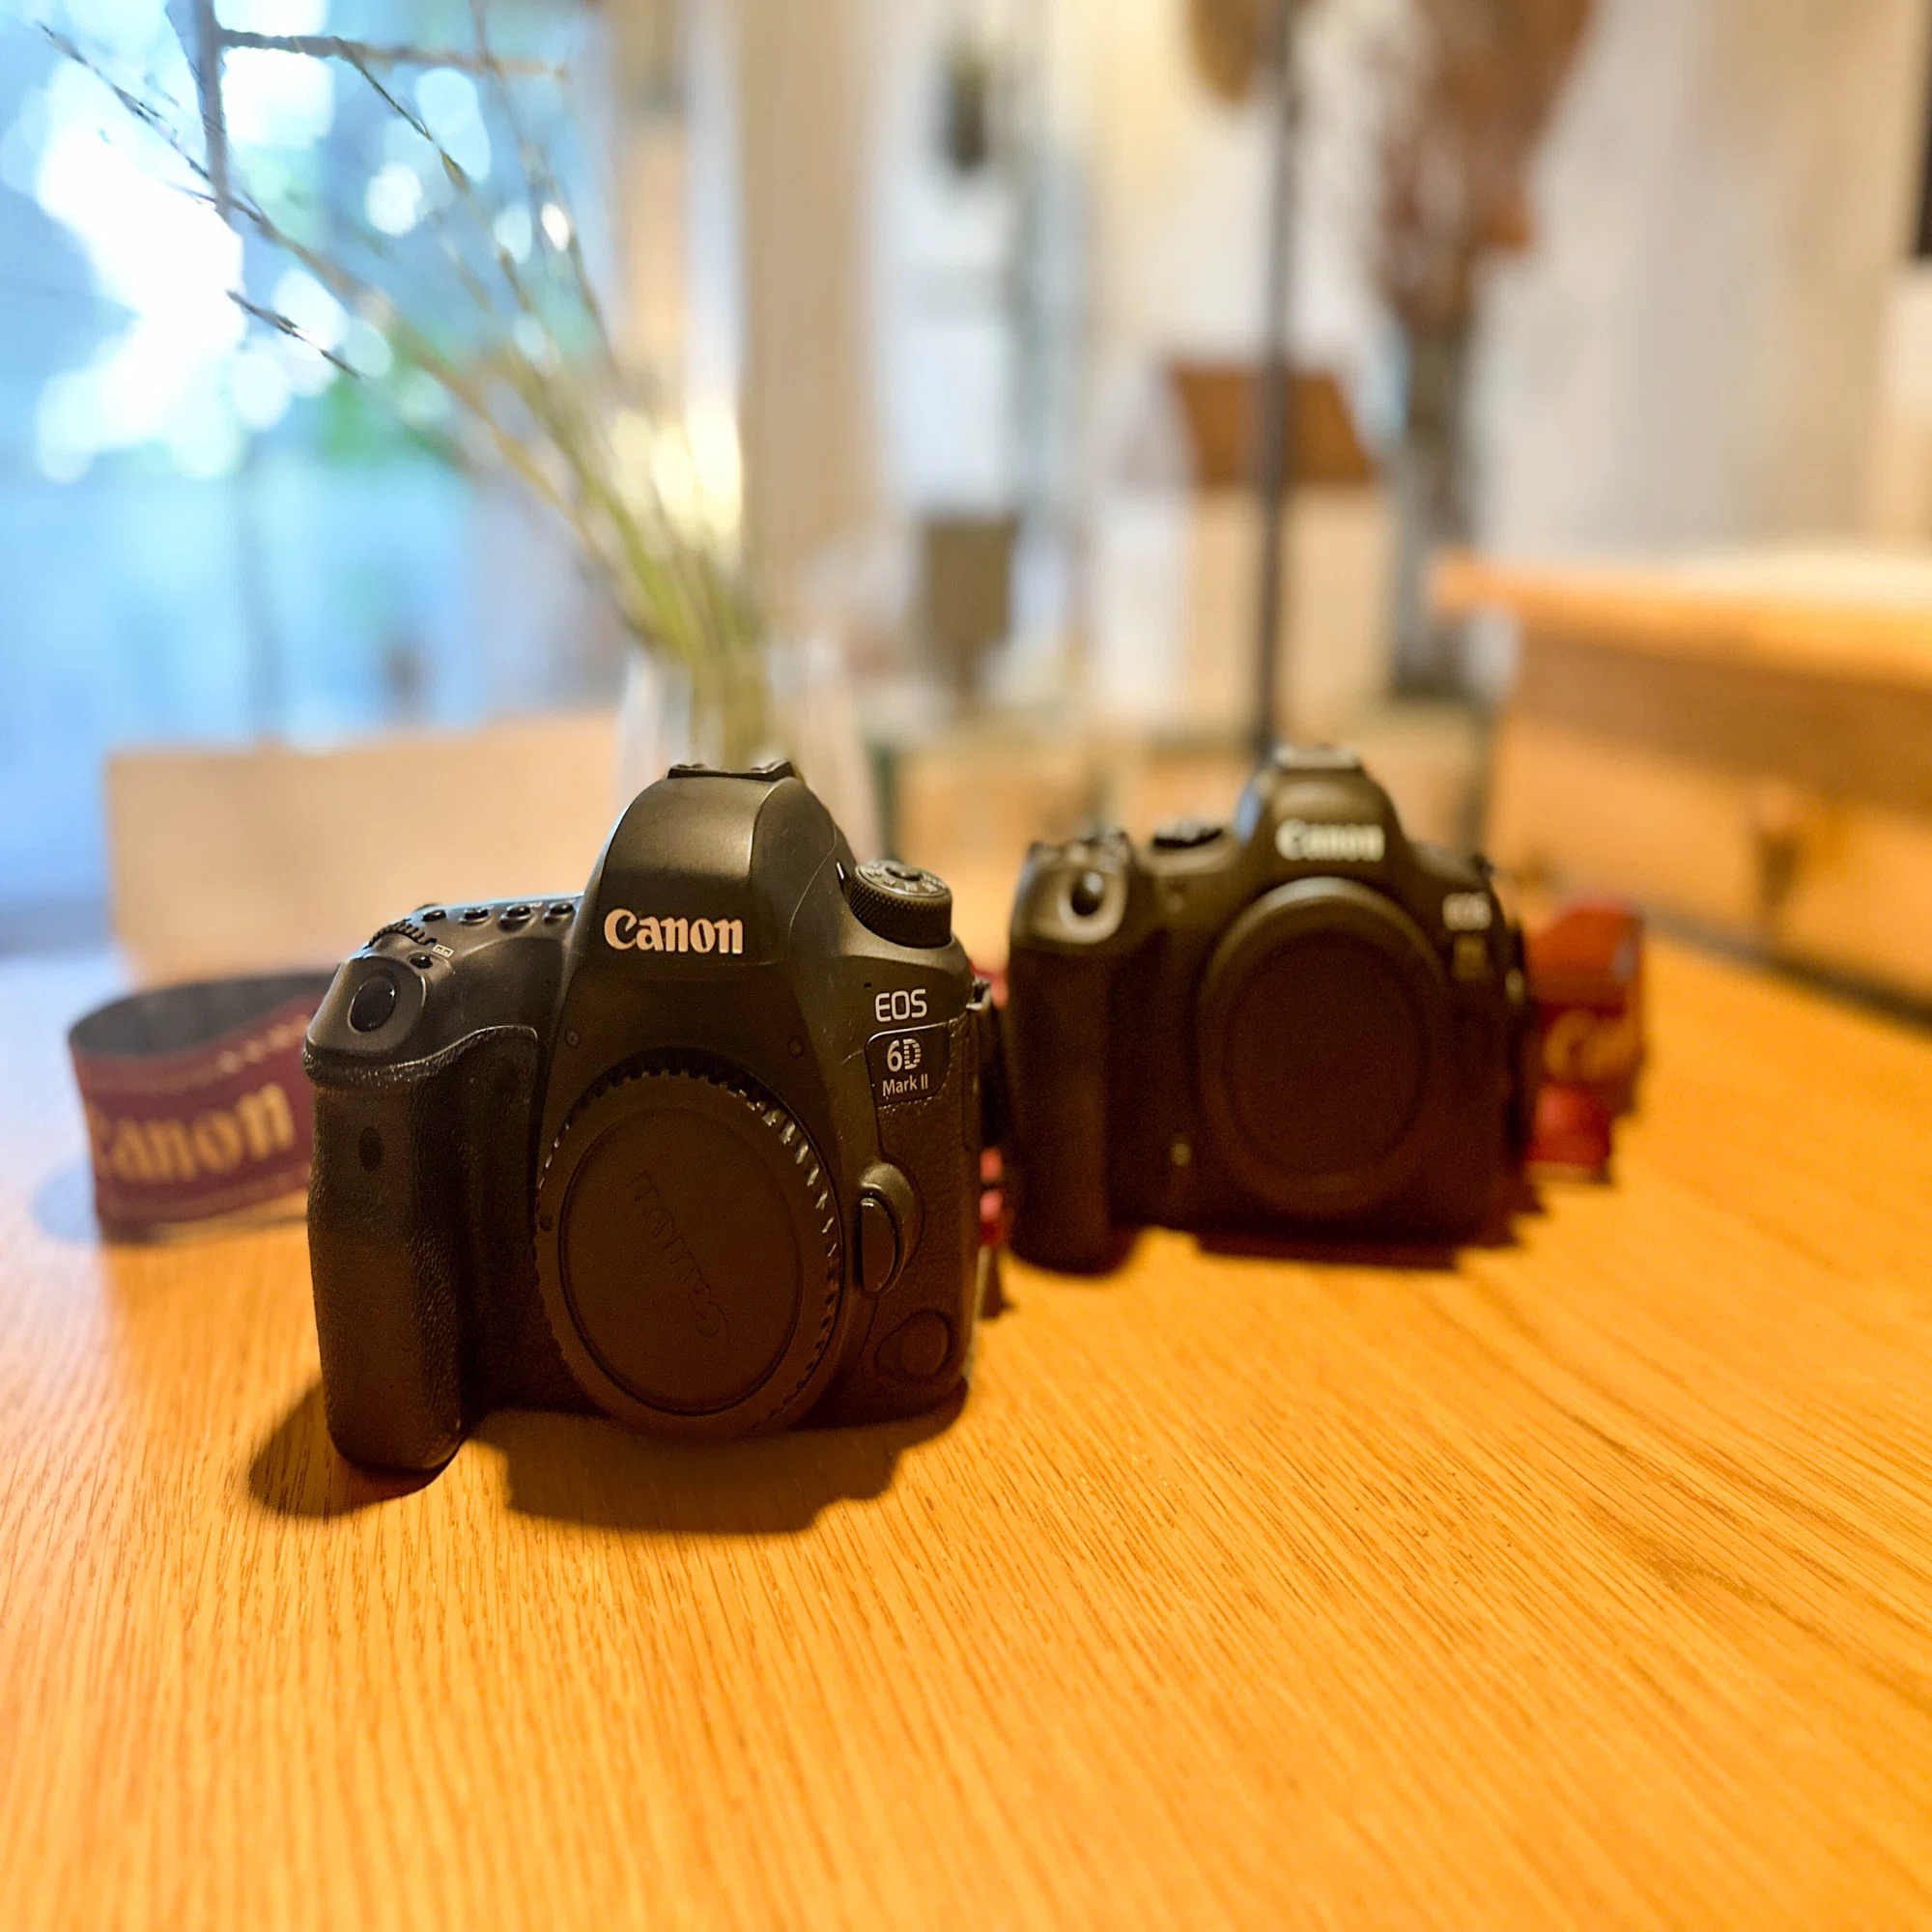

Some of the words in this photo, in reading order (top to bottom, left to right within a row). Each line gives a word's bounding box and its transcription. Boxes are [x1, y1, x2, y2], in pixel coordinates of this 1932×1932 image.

[604, 908, 743, 954] Canon
[875, 988, 927, 1022] EOS
[887, 1038, 922, 1072] 6D
[882, 1073, 918, 1097] Mark
[921, 1073, 928, 1090] II
